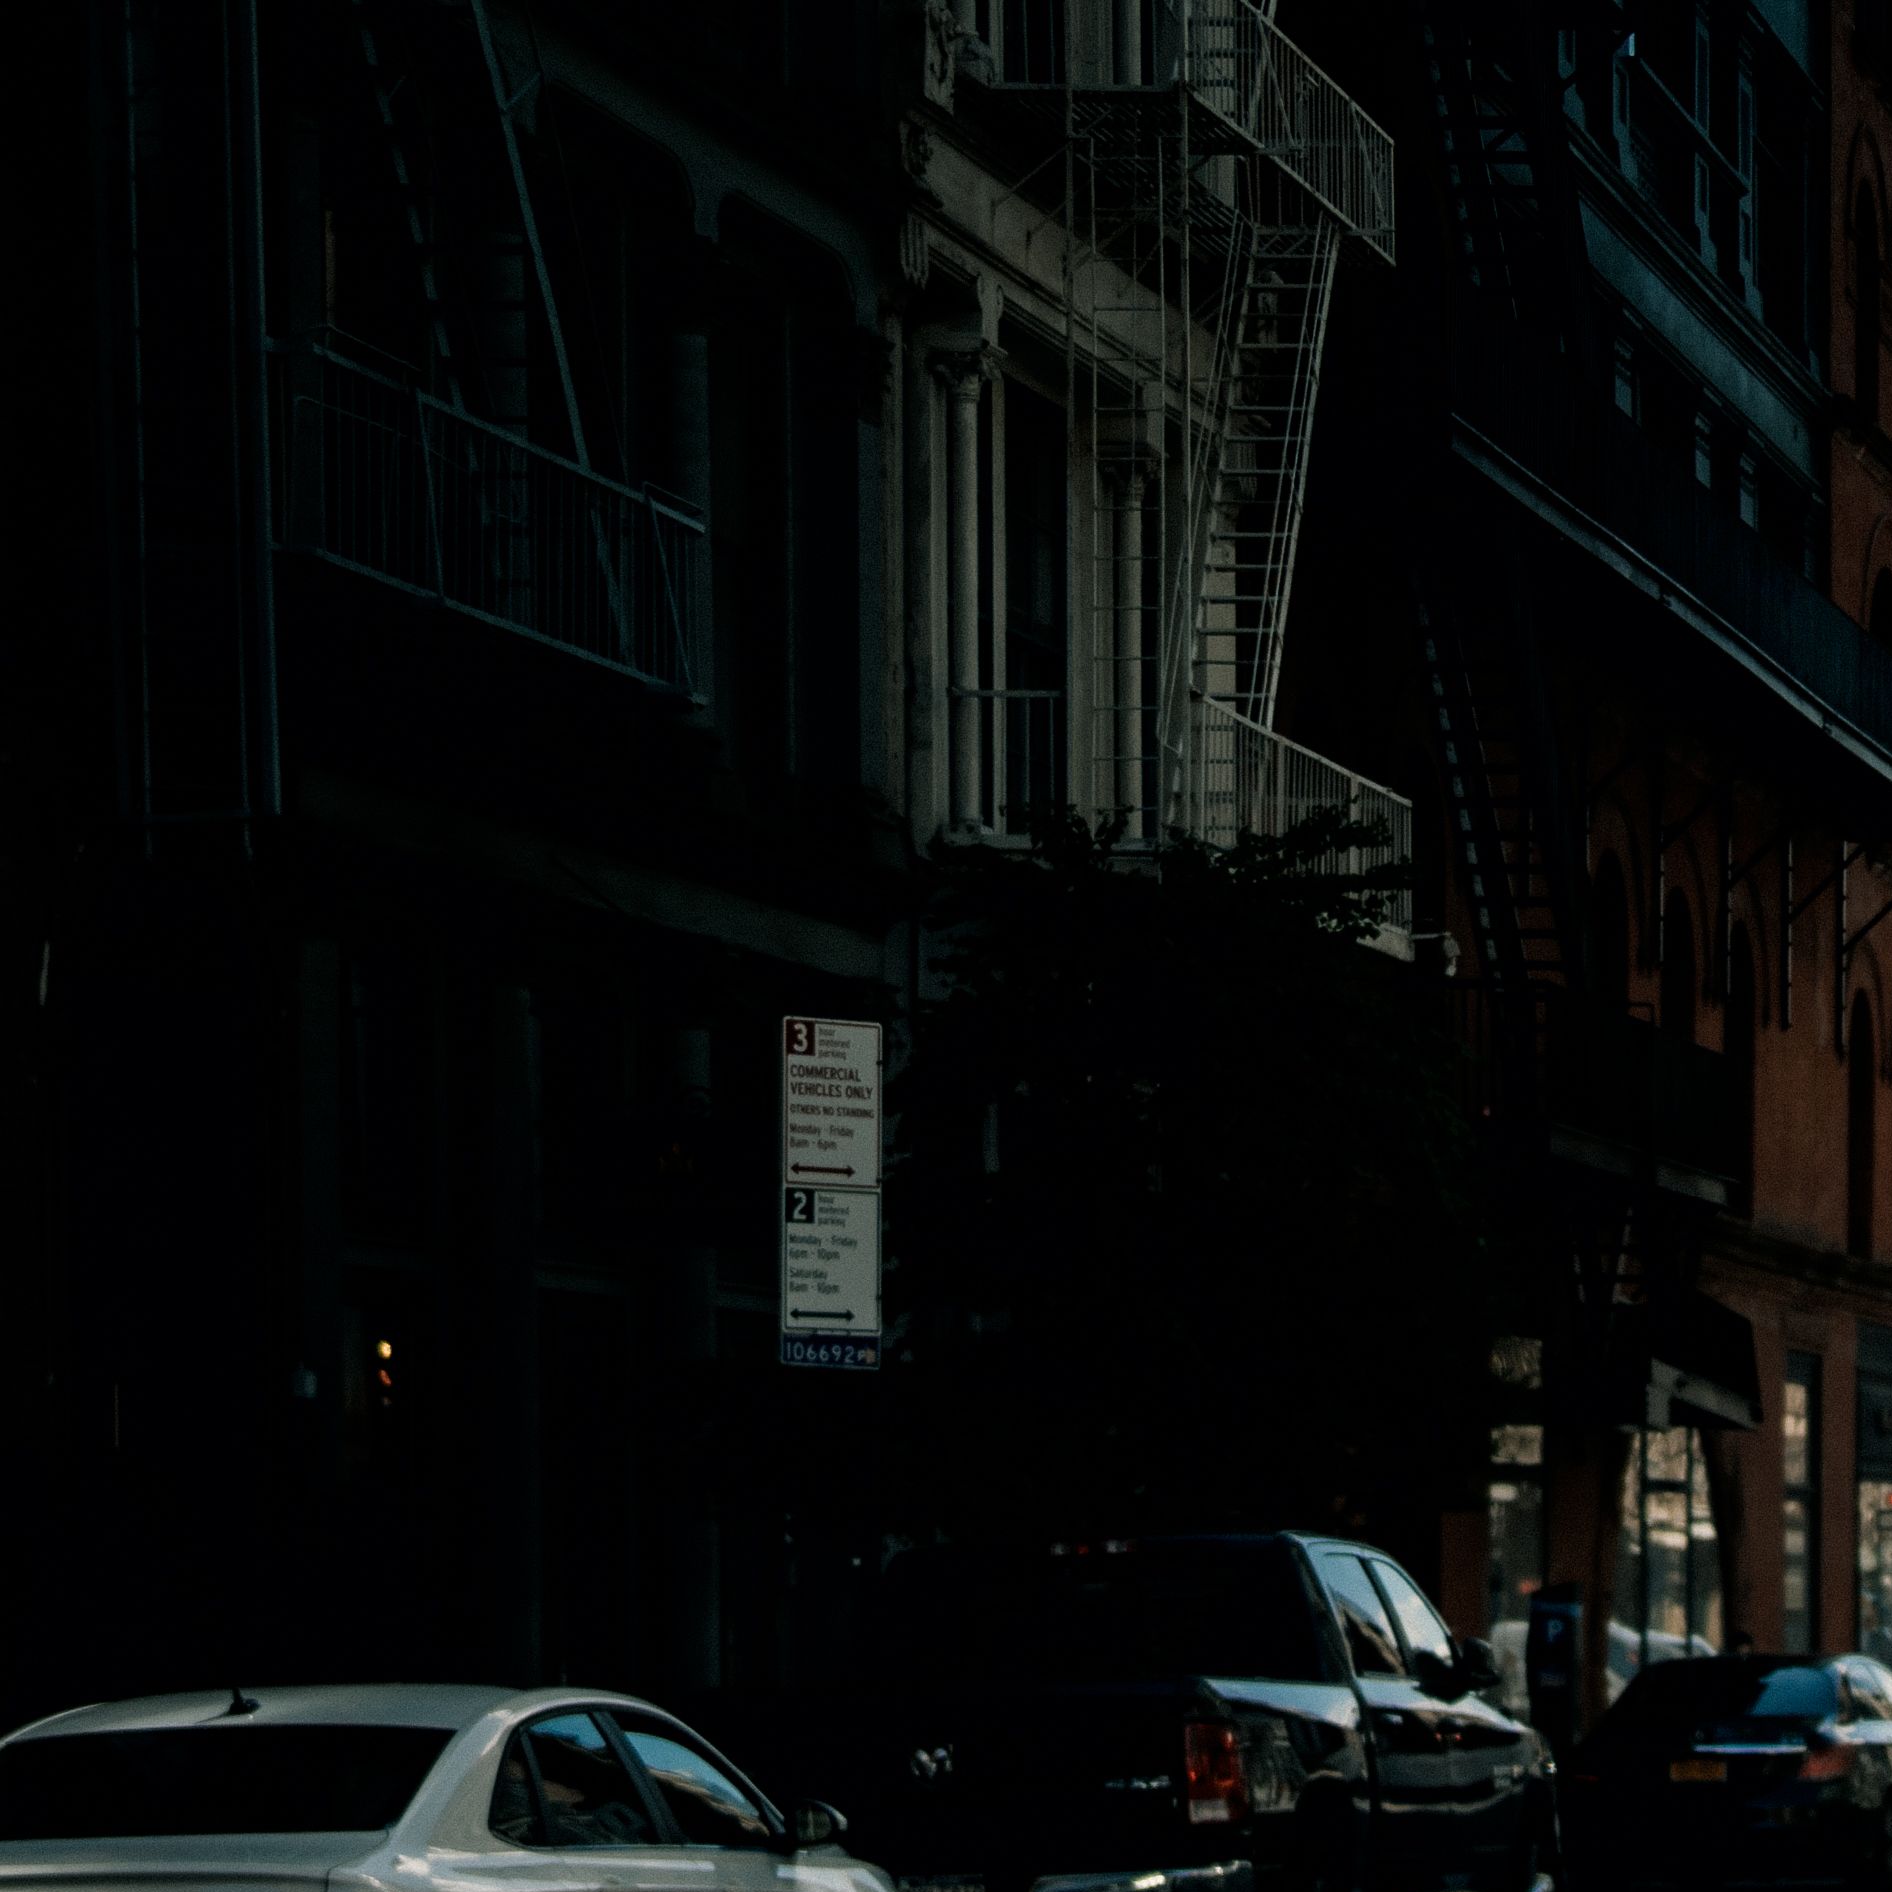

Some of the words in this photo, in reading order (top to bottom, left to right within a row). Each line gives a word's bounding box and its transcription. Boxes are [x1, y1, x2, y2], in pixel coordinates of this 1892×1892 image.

[792, 1022, 809, 1053] 3
[790, 1065, 861, 1082] COMMERCIAL
[790, 1082, 841, 1098] VEHICLES
[845, 1086, 873, 1099] ONLY
[790, 1103, 821, 1116] OTHERS
[823, 1106, 834, 1116] NO
[837, 1106, 875, 1119] STANDING
[792, 1191, 808, 1220] 2
